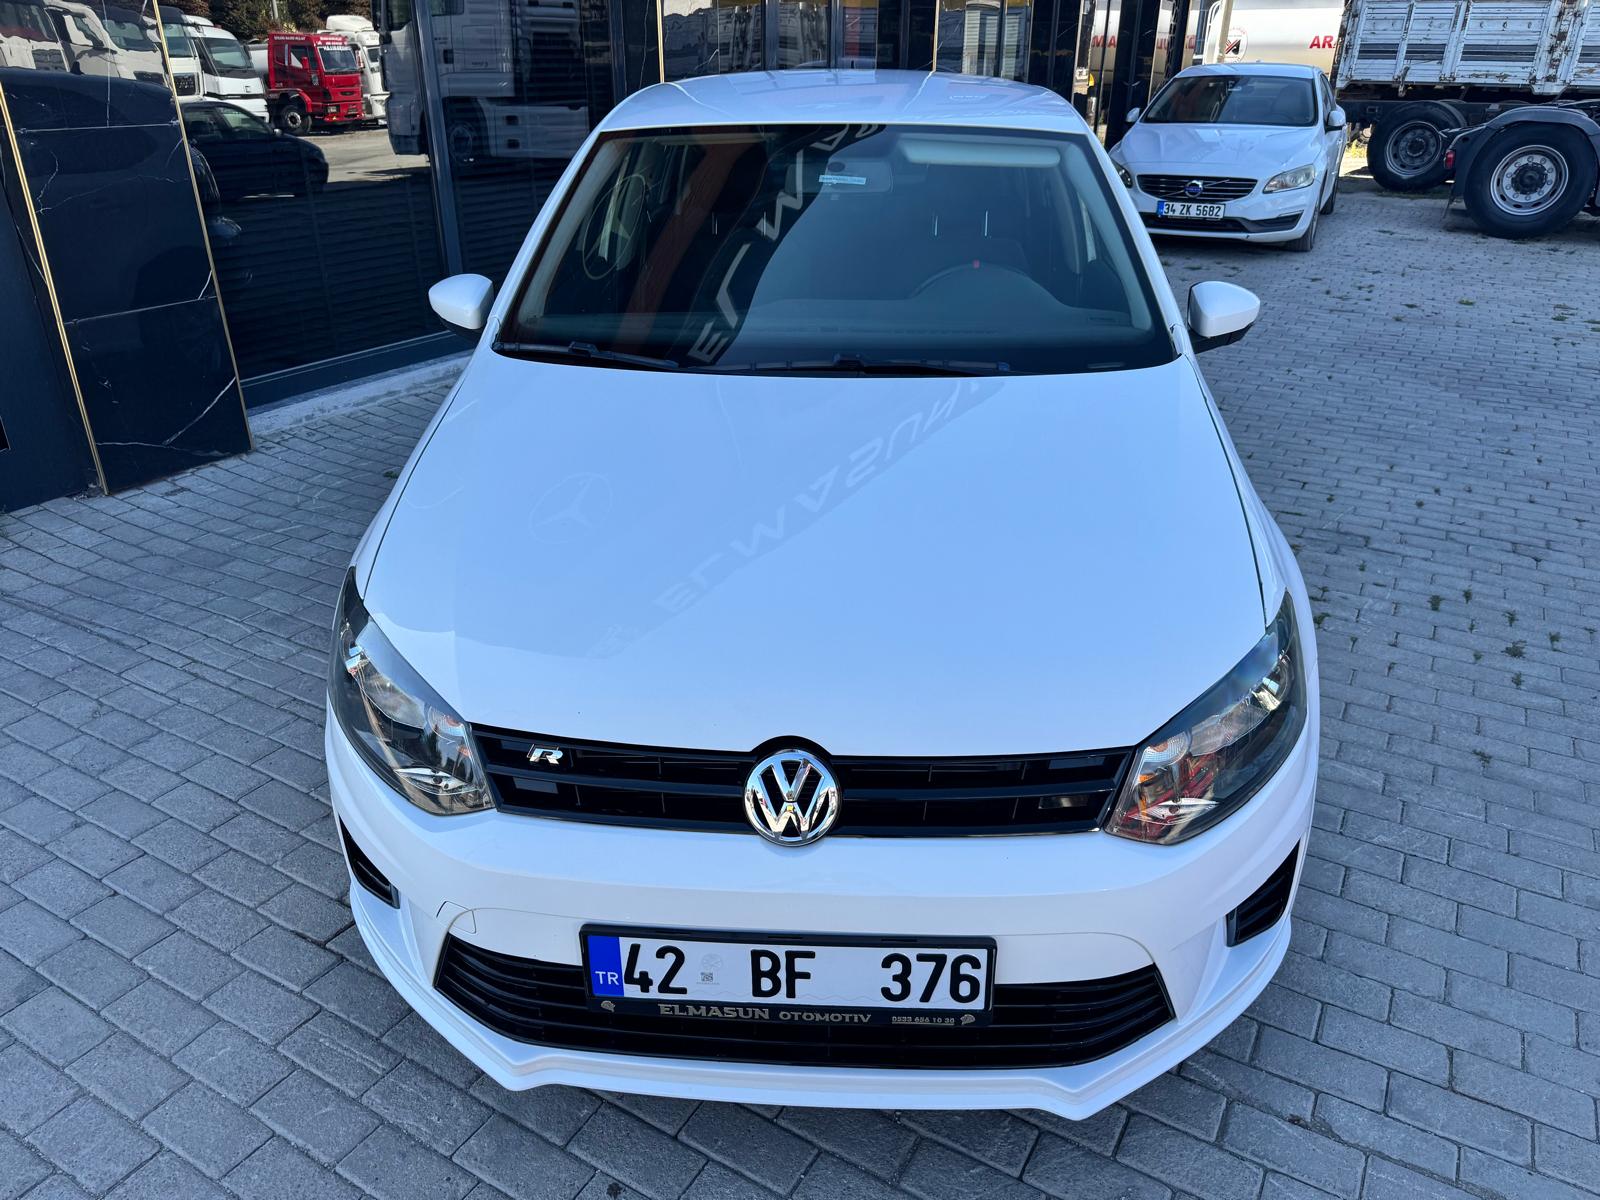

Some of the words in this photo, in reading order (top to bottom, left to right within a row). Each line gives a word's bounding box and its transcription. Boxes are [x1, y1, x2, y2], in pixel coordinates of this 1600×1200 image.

[1309, 35, 1335, 49] AR
[1164, 203, 1176, 215] 34
[1179, 204, 1192, 216] ZK
[1195, 205, 1222, 217] 5682
[526, 743, 564, 765] R
[594, 969, 620, 987] TR
[623, 942, 689, 995] 42
[750, 949, 816, 999] BF
[880, 953, 982, 1004] 376
[658, 1003, 770, 1019] ELMASUN
[778, 1010, 872, 1025] OTOMOTIV
